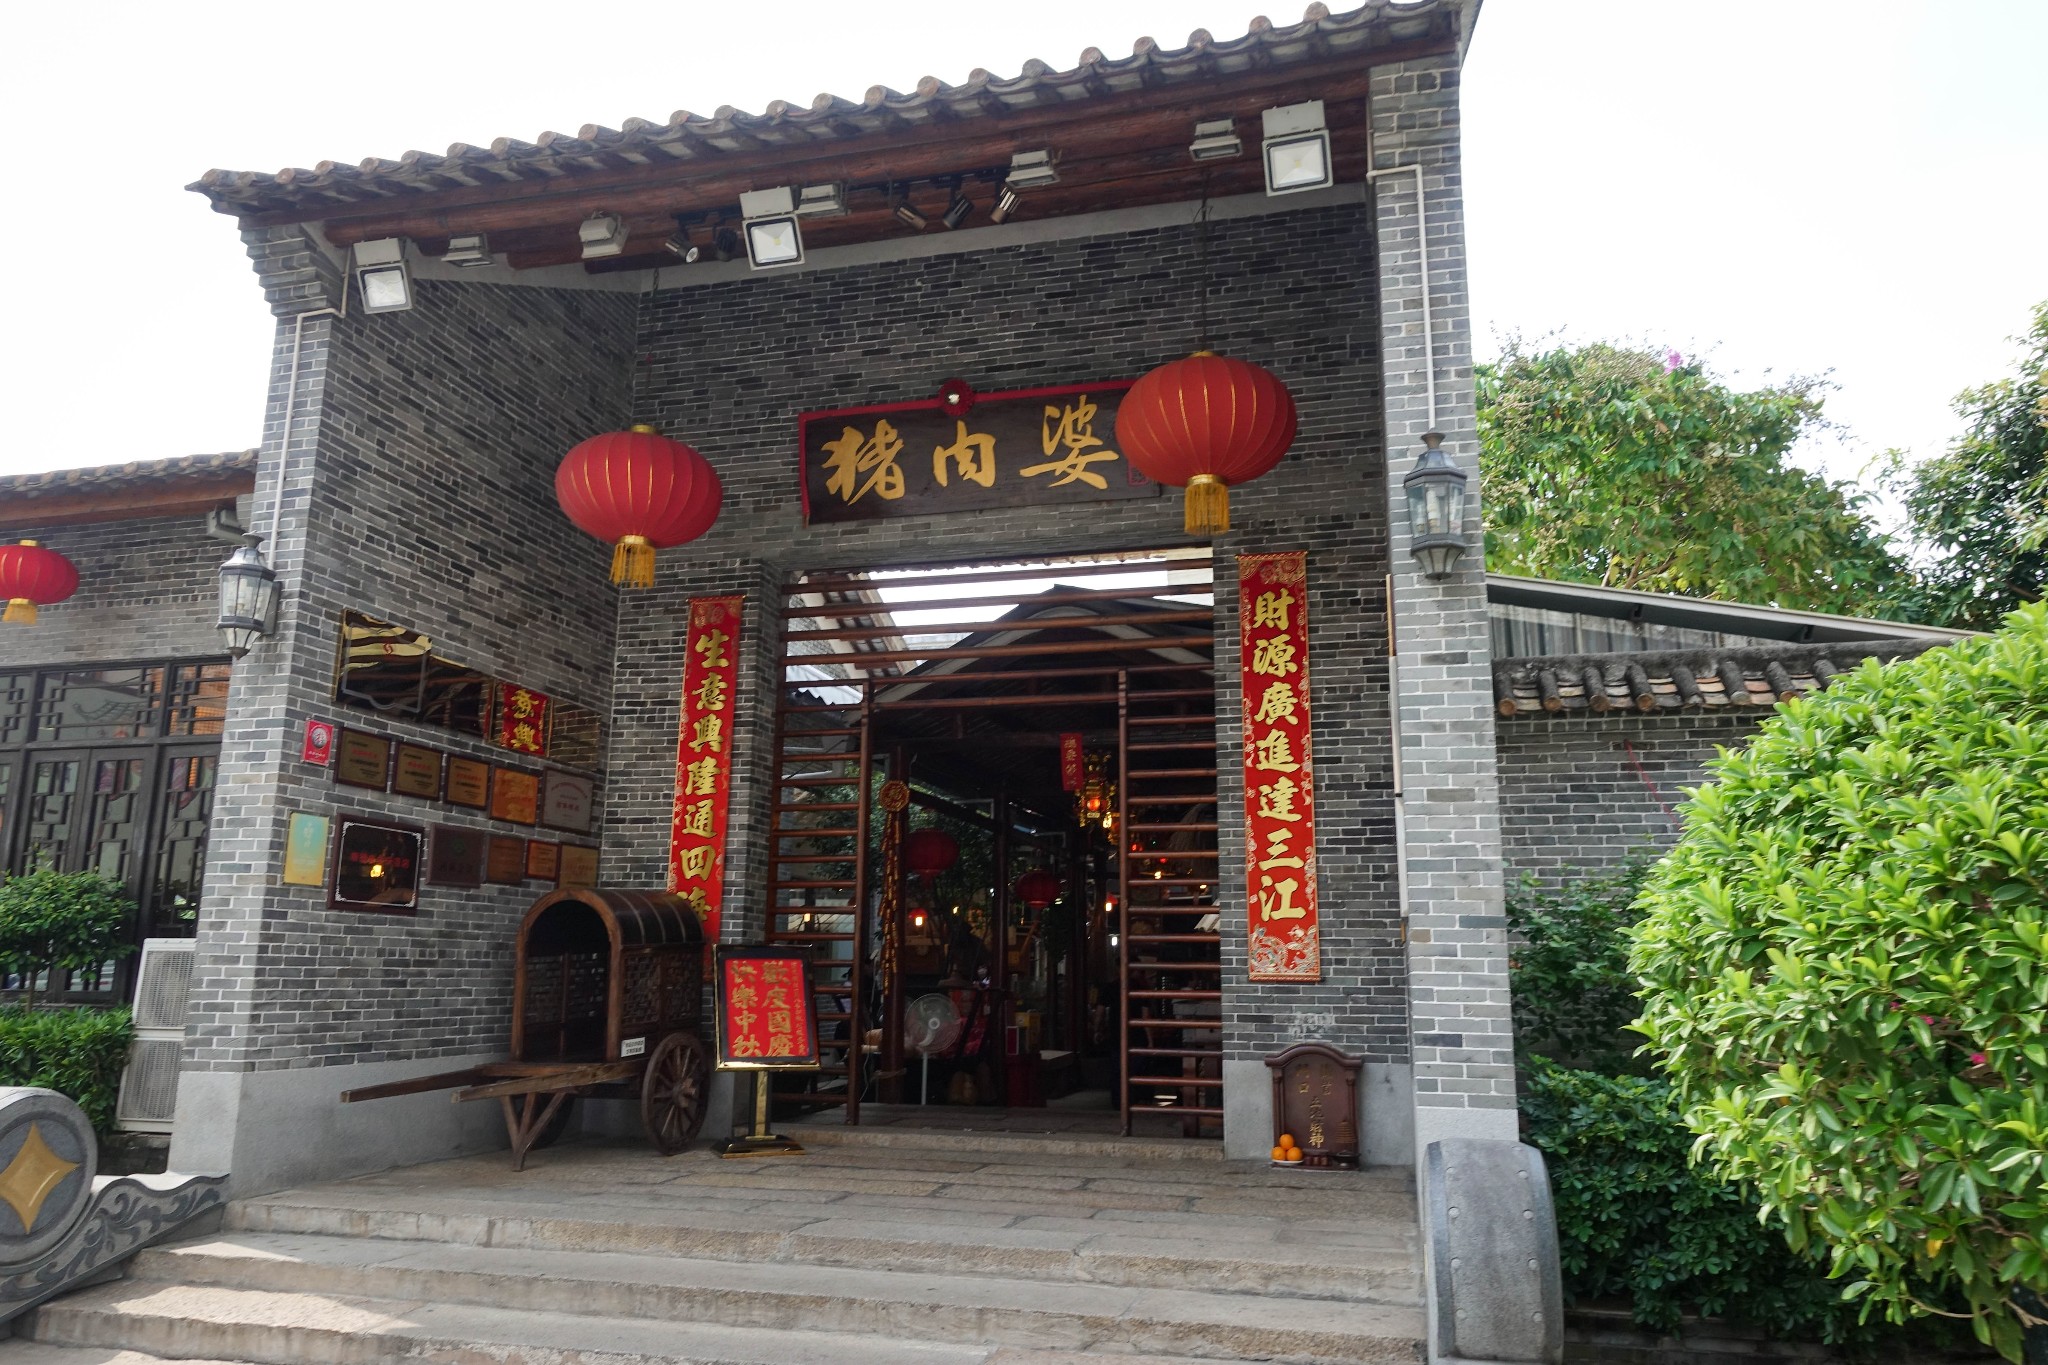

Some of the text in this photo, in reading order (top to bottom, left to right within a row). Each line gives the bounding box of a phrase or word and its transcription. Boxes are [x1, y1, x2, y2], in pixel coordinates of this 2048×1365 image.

[821, 394, 1119, 505] 猪肉婆
[1252, 588, 1307, 922] 財源廣進達三江
[731, 960, 762, 1057] 快樂中秋
[761, 961, 794, 1057] 歡度國慶
